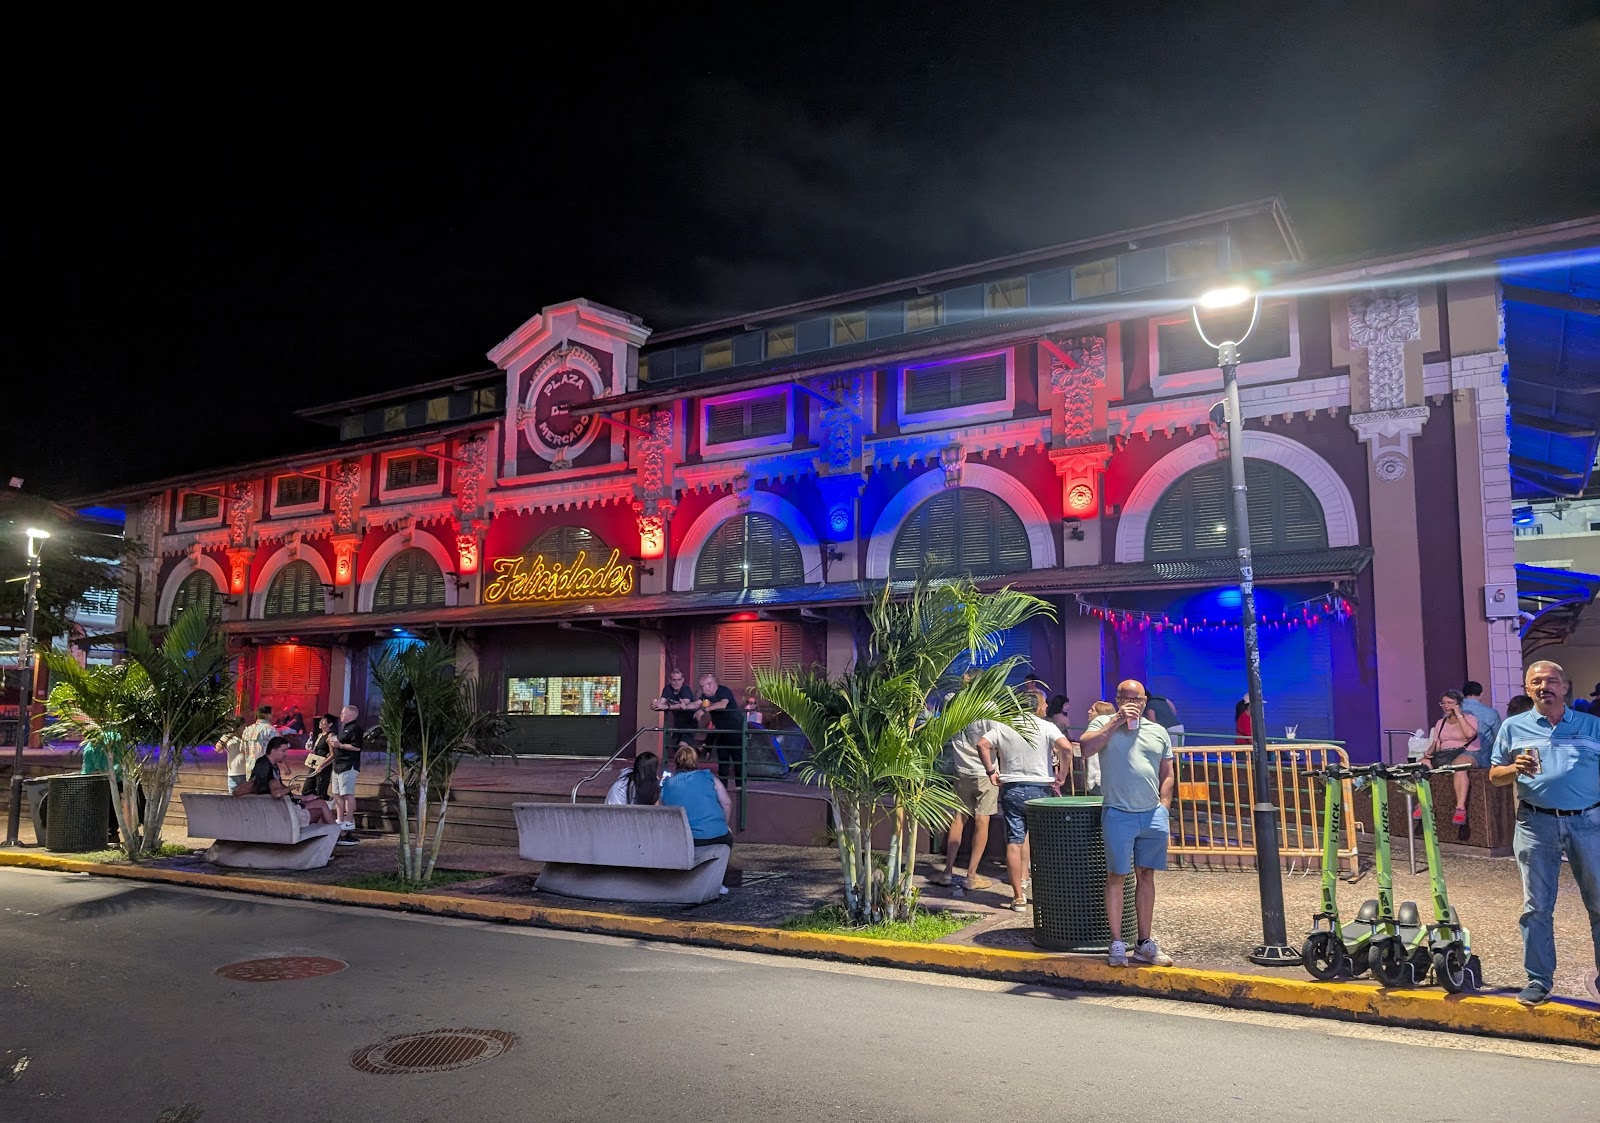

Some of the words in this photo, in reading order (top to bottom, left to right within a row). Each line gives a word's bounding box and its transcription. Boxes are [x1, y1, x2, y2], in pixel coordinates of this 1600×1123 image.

[543, 374, 585, 396] PLAZA
[538, 415, 589, 445] MERCADO
[484, 548, 633, 602] Felicidades
[1495, 588, 1506, 602] 6
